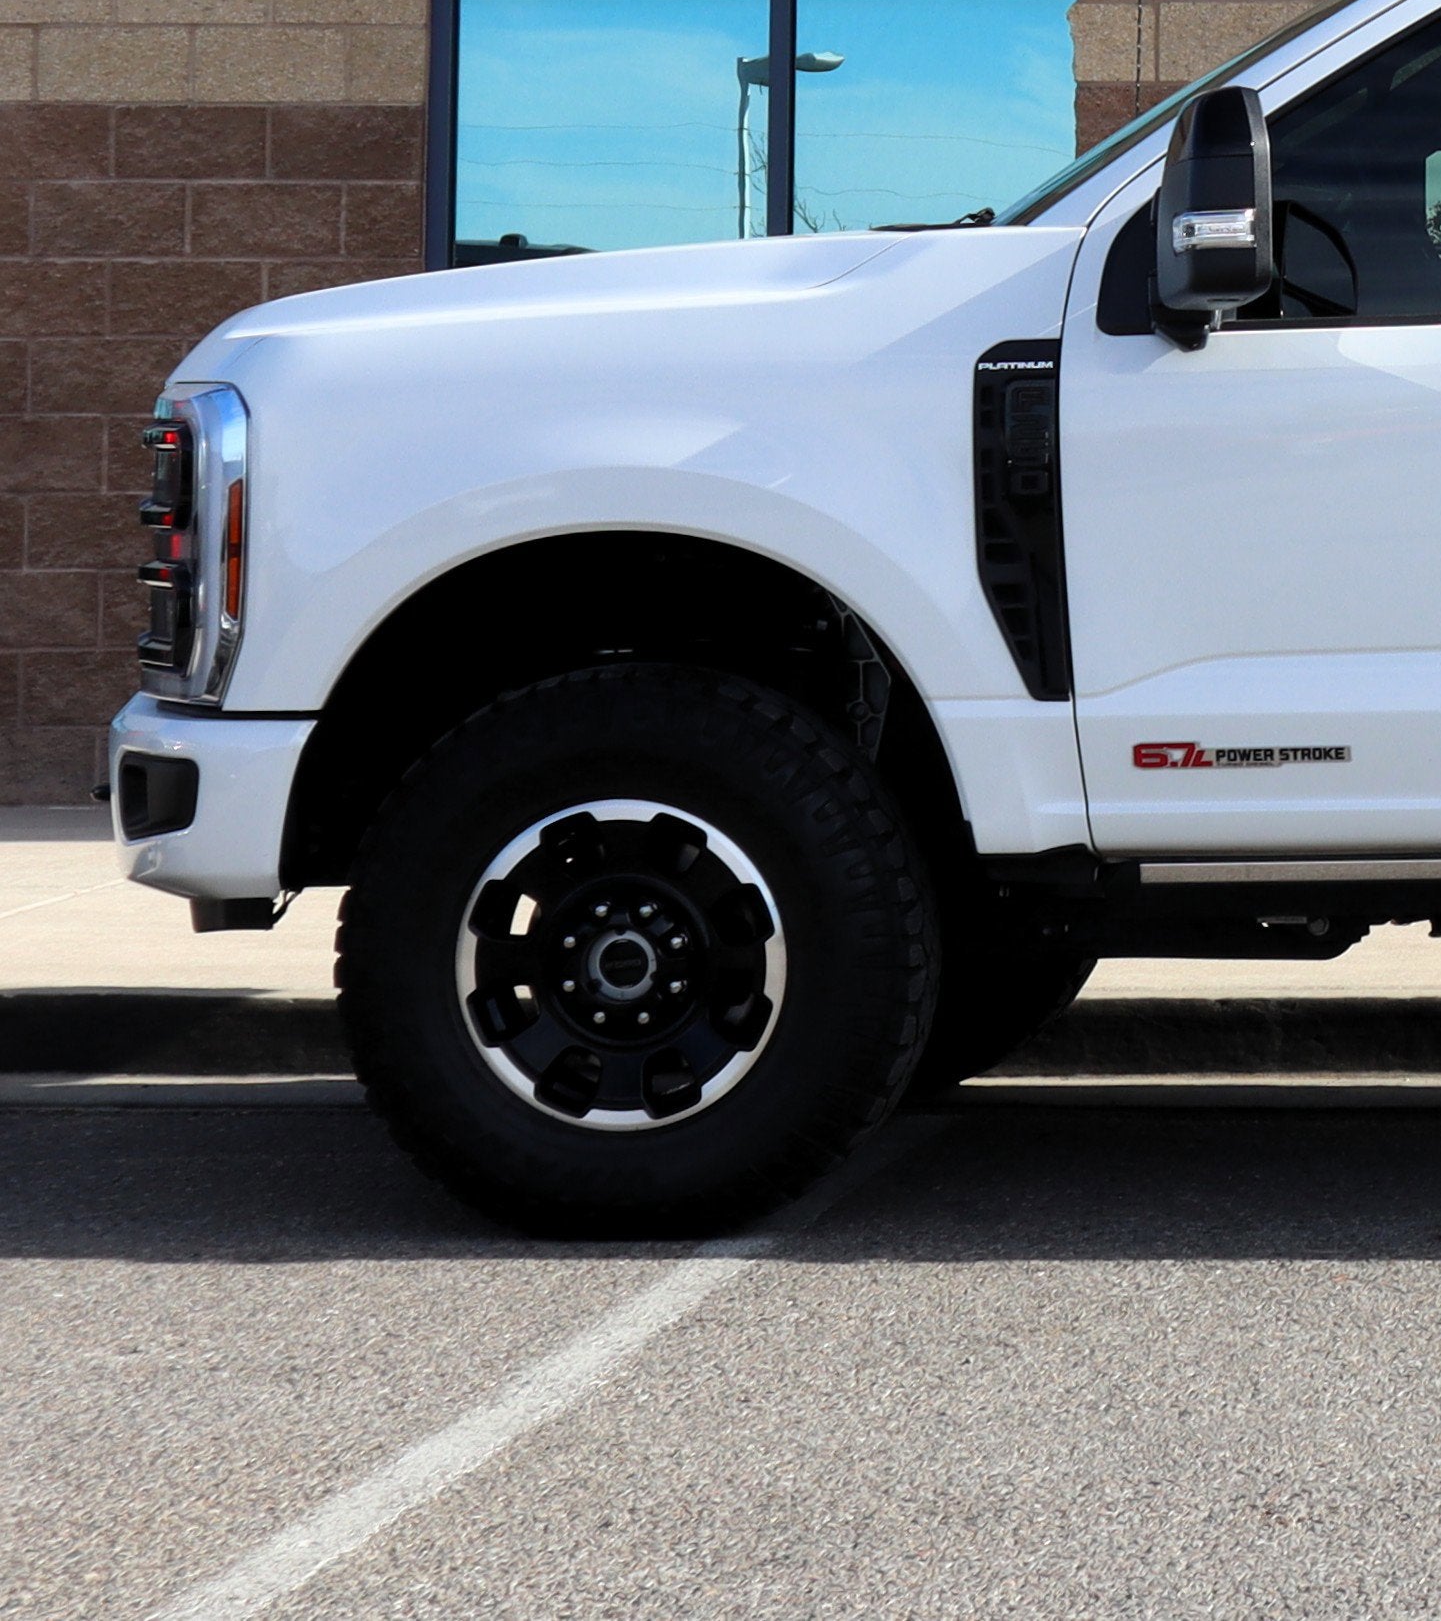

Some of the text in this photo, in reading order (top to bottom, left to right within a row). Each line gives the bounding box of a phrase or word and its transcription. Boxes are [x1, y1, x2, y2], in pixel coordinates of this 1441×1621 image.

[977, 361, 1054, 371] PLATINUM
[1132, 742, 1213, 769] 6.7L
[1215, 748, 1275, 763] POWER
[1279, 746, 1346, 761] STROKE
